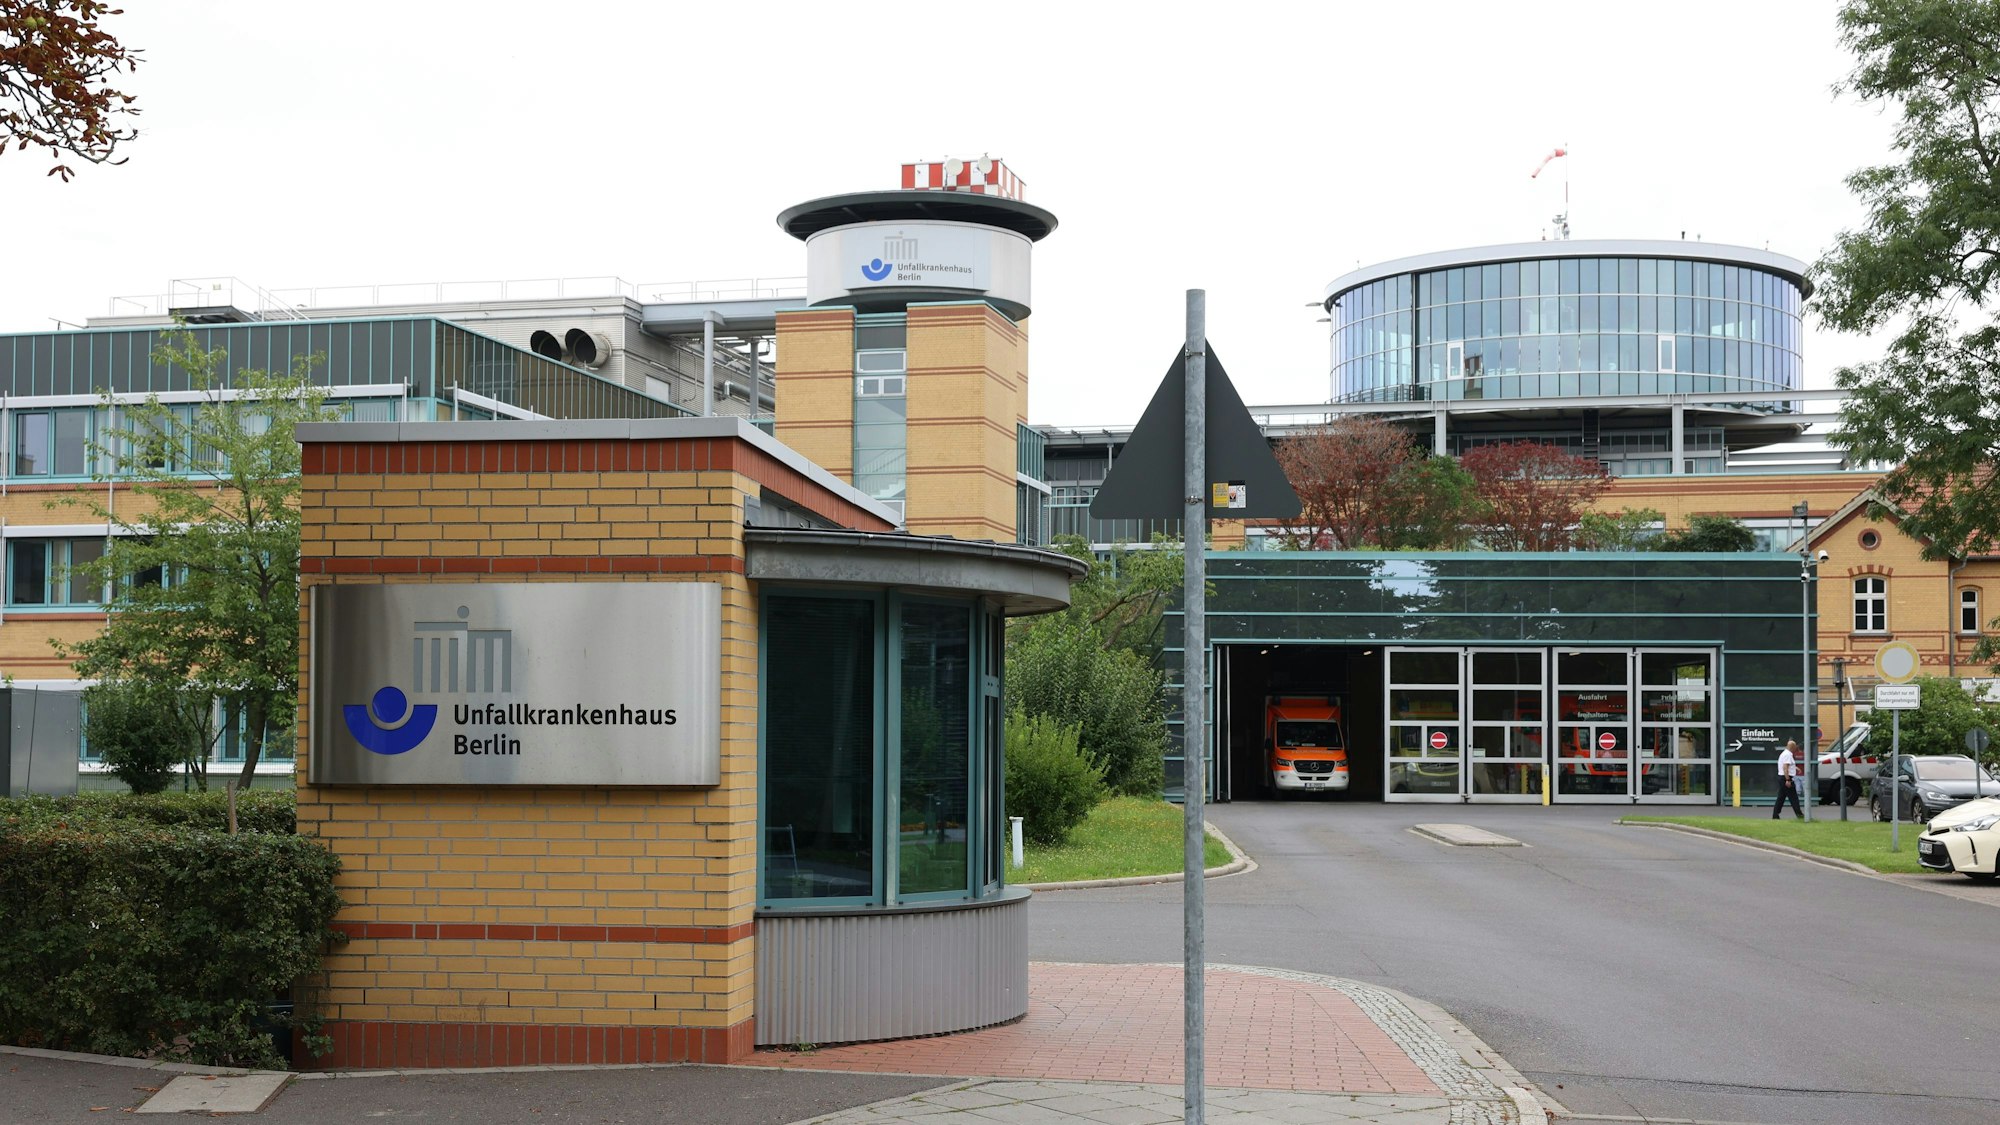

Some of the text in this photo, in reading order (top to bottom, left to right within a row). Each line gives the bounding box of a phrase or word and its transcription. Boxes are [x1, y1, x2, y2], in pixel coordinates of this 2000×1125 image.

[897, 263, 972, 273] Unfallkrankenhaus
[897, 273, 922, 281] Berlin
[1577, 693, 1608, 701] Ausfahrt
[454, 703, 677, 725] Unfallkrankenhaus
[1577, 711, 1609, 719] freihalten
[1741, 729, 1774, 737] Einfahrt
[454, 734, 521, 755] Berlin
